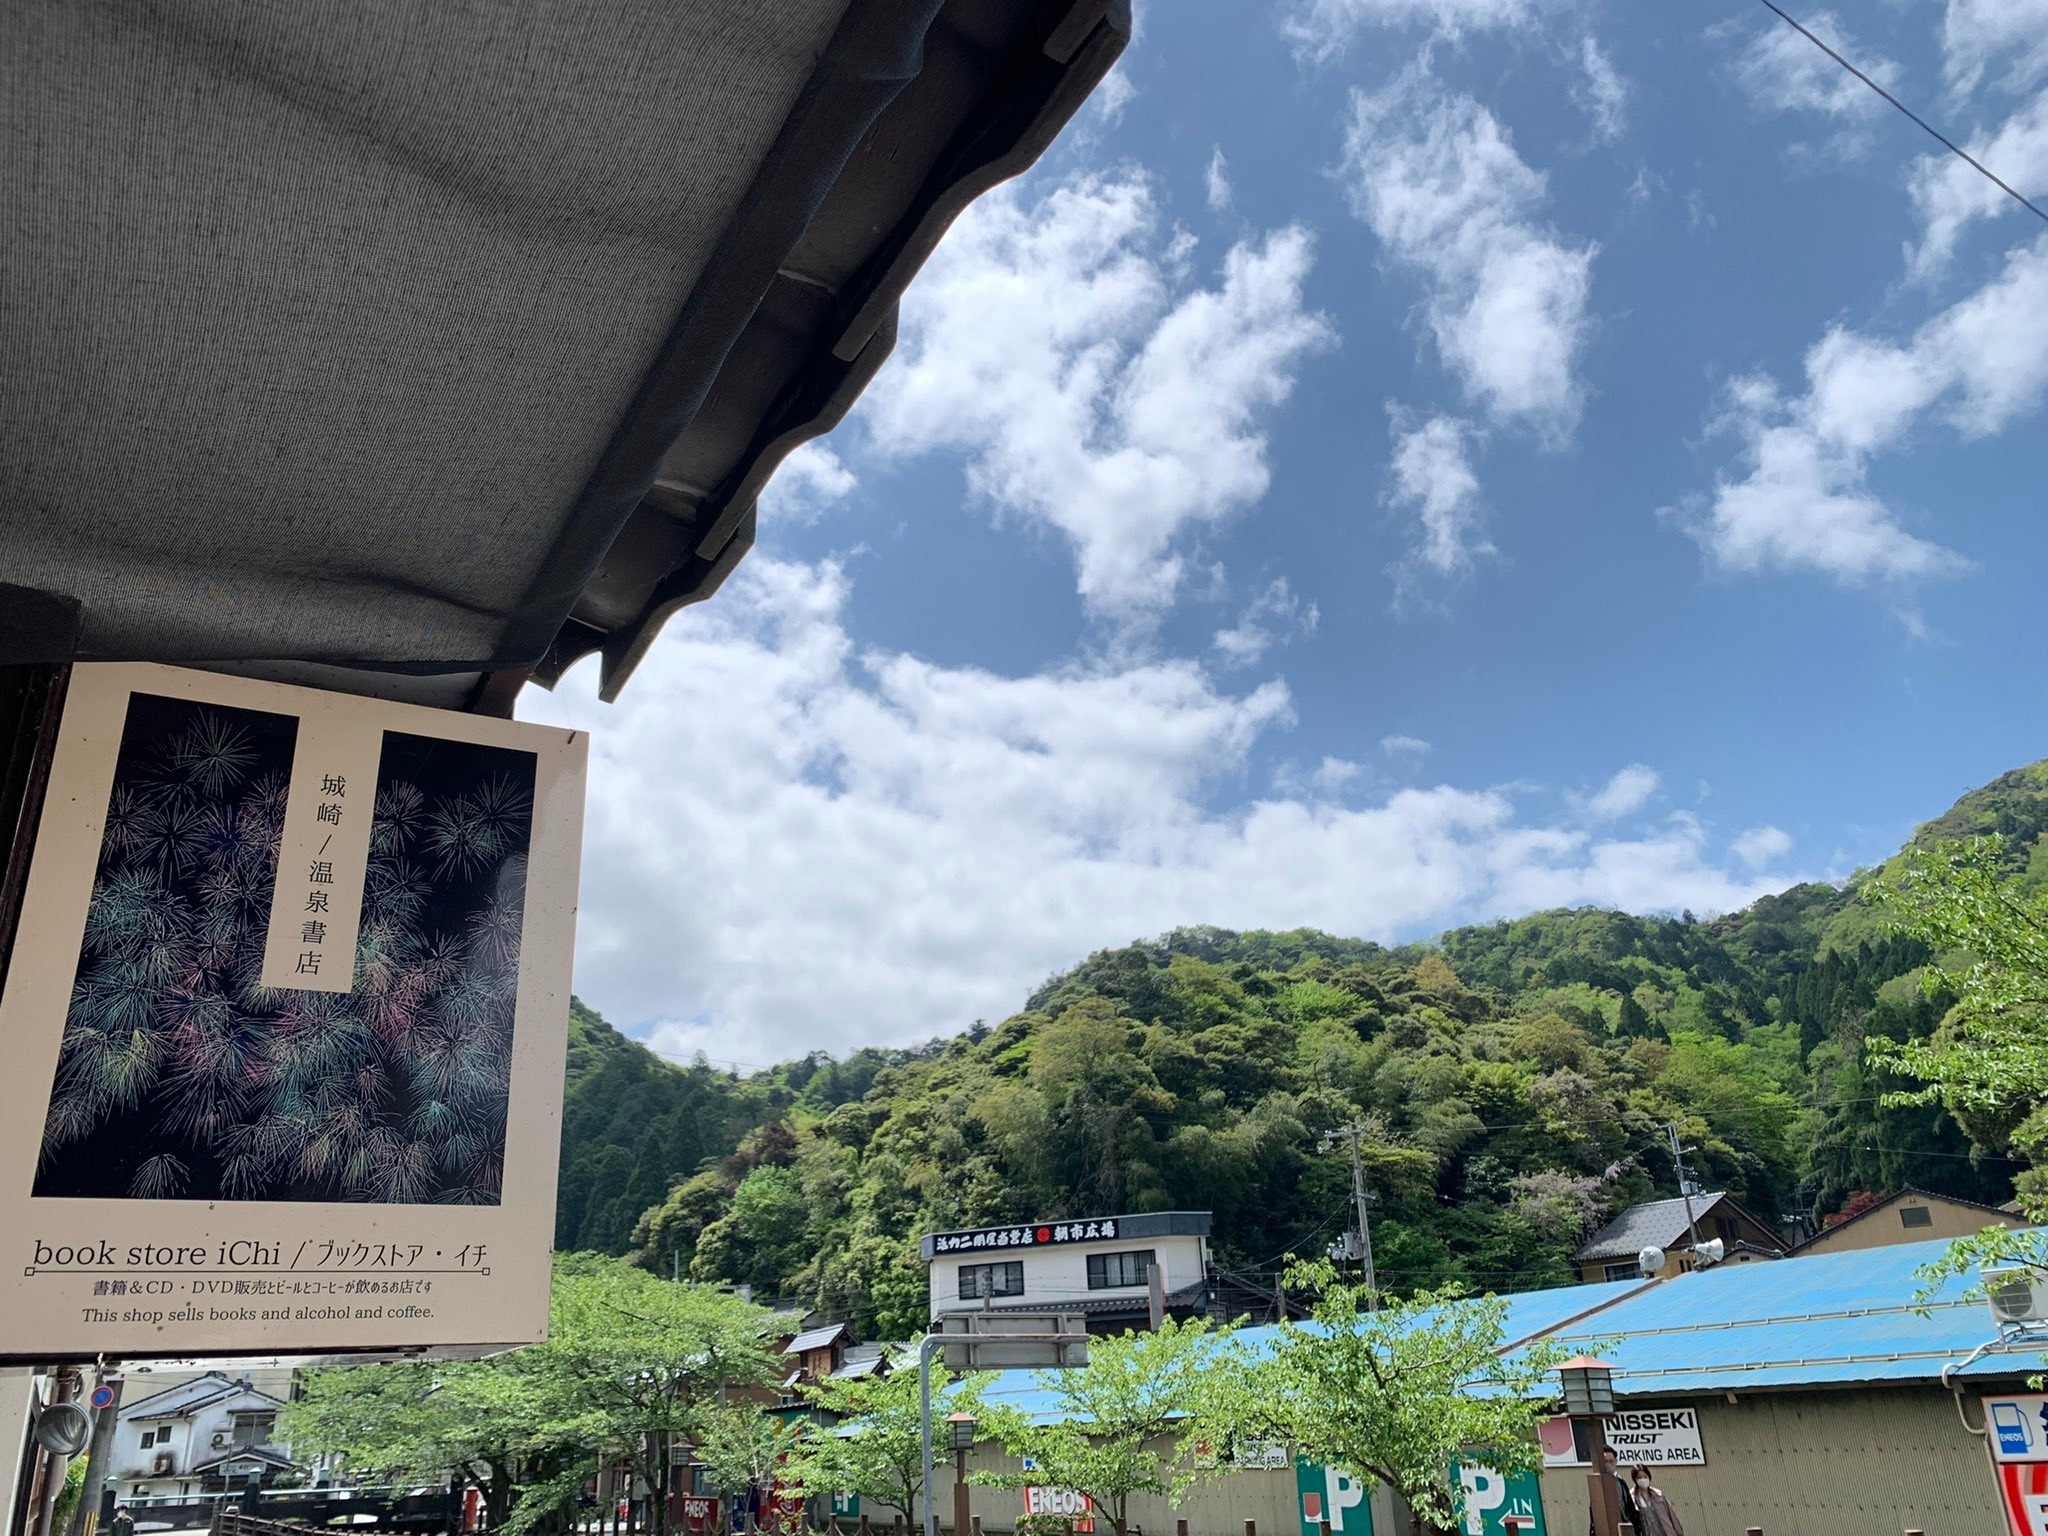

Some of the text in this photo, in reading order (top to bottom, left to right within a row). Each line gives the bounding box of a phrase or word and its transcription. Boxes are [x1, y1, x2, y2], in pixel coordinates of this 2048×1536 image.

[1054, 1220, 1116, 1243] 朝市広場
[33, 1239, 117, 1266] book
[126, 1243, 206, 1266] store
[216, 1240, 281, 1266] iChi
[82, 1305, 435, 1324] This shop sells books and alcohol and coffee.
[1606, 1411, 1695, 1431] NISSEKI
[1607, 1432, 1664, 1445] TRUST
[2000, 1432, 2024, 1442] ENEOS
[1618, 1447, 1701, 1462] ARKING AREA
[1029, 1485, 1087, 1515] ENEOS
[1325, 1464, 1364, 1532] P
[1459, 1463, 1506, 1536] P
[1512, 1497, 1533, 1515] IN
